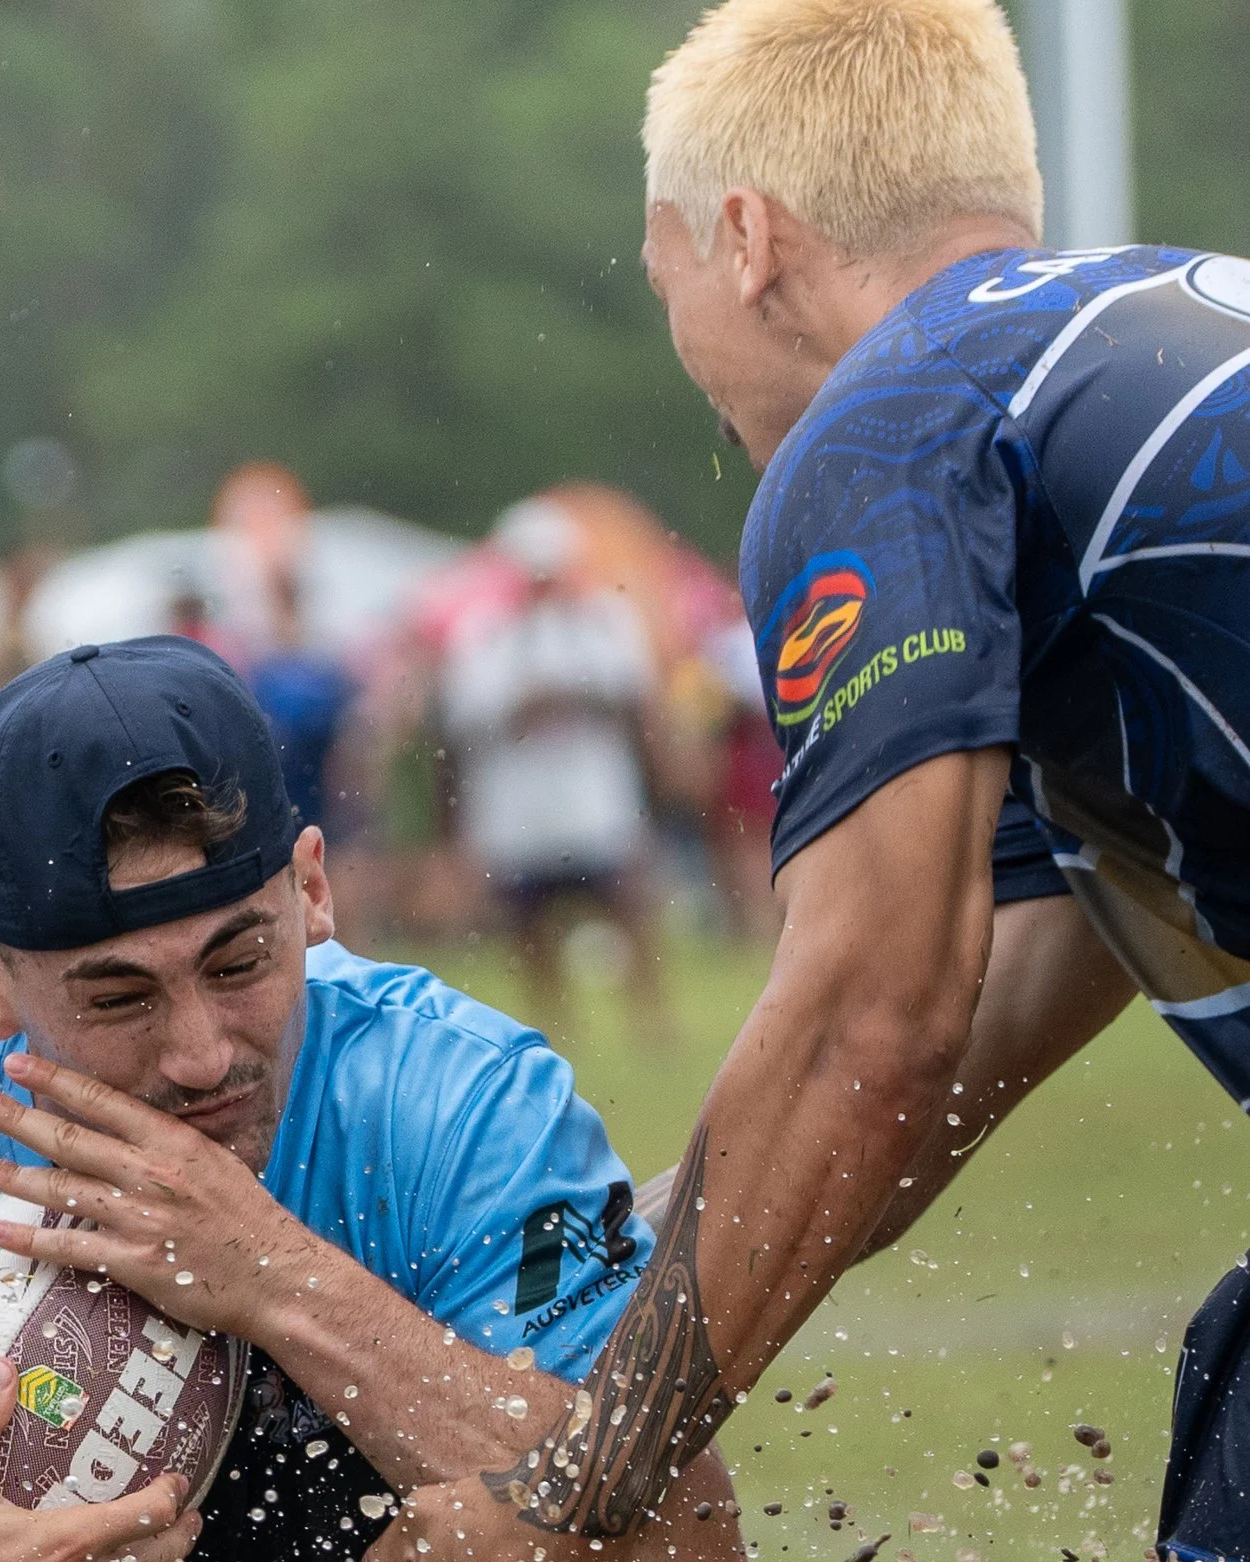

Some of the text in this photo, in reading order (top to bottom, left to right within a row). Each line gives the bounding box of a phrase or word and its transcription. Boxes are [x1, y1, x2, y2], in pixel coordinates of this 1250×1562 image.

[822, 627, 967, 732] SPORTS CLUB
[107, 1286, 132, 1374] EEDEN
[521, 1260, 650, 1339] AUSVETERA
[33, 1313, 203, 1512] TEED
